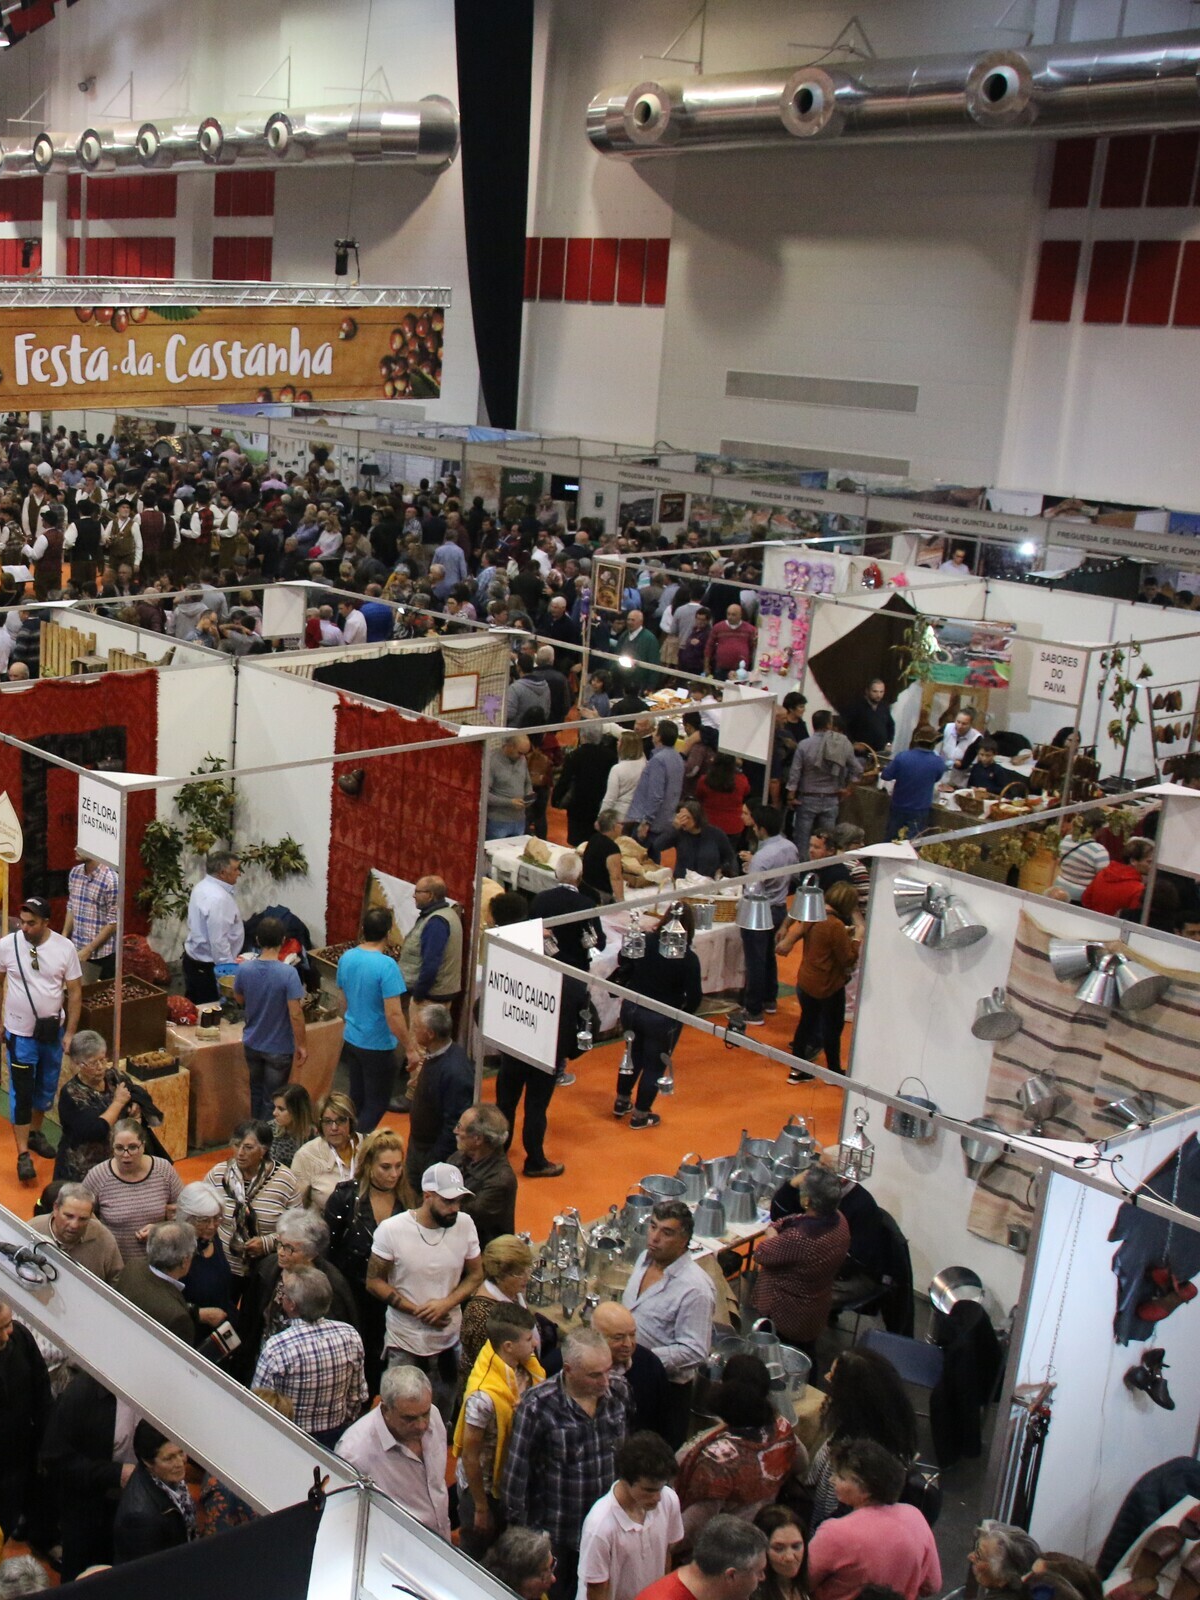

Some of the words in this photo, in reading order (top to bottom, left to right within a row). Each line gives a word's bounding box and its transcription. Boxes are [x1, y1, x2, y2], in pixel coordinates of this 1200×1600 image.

[14, 333, 109, 387] Festa
[120, 339, 154, 376] da
[165, 327, 333, 384] Castanha
[912, 511, 949, 522] FREGUESIA
[962, 518, 996, 529] QUINTELA
[997, 522, 1008, 530] DA
[1009, 524, 1029, 533] LAPA
[1056, 531, 1098, 543] FREGUESIA
[1100, 536, 1110, 544] DE
[1112, 538, 1170, 553] SERNANCELHE
[1040, 651, 1078, 668] SABORES
[1051, 668, 1063, 679] DO
[1044, 680, 1066, 694] PAIVA
[82, 796, 92, 811] ZÉ
[92, 801, 118, 823] FLORA
[81, 813, 118, 840] (CASTANHA)
[488, 969, 524, 1000] ANTÓNIO
[525, 985, 556, 1014] CAIADO
[502, 1001, 538, 1034] (LATOARIA)
